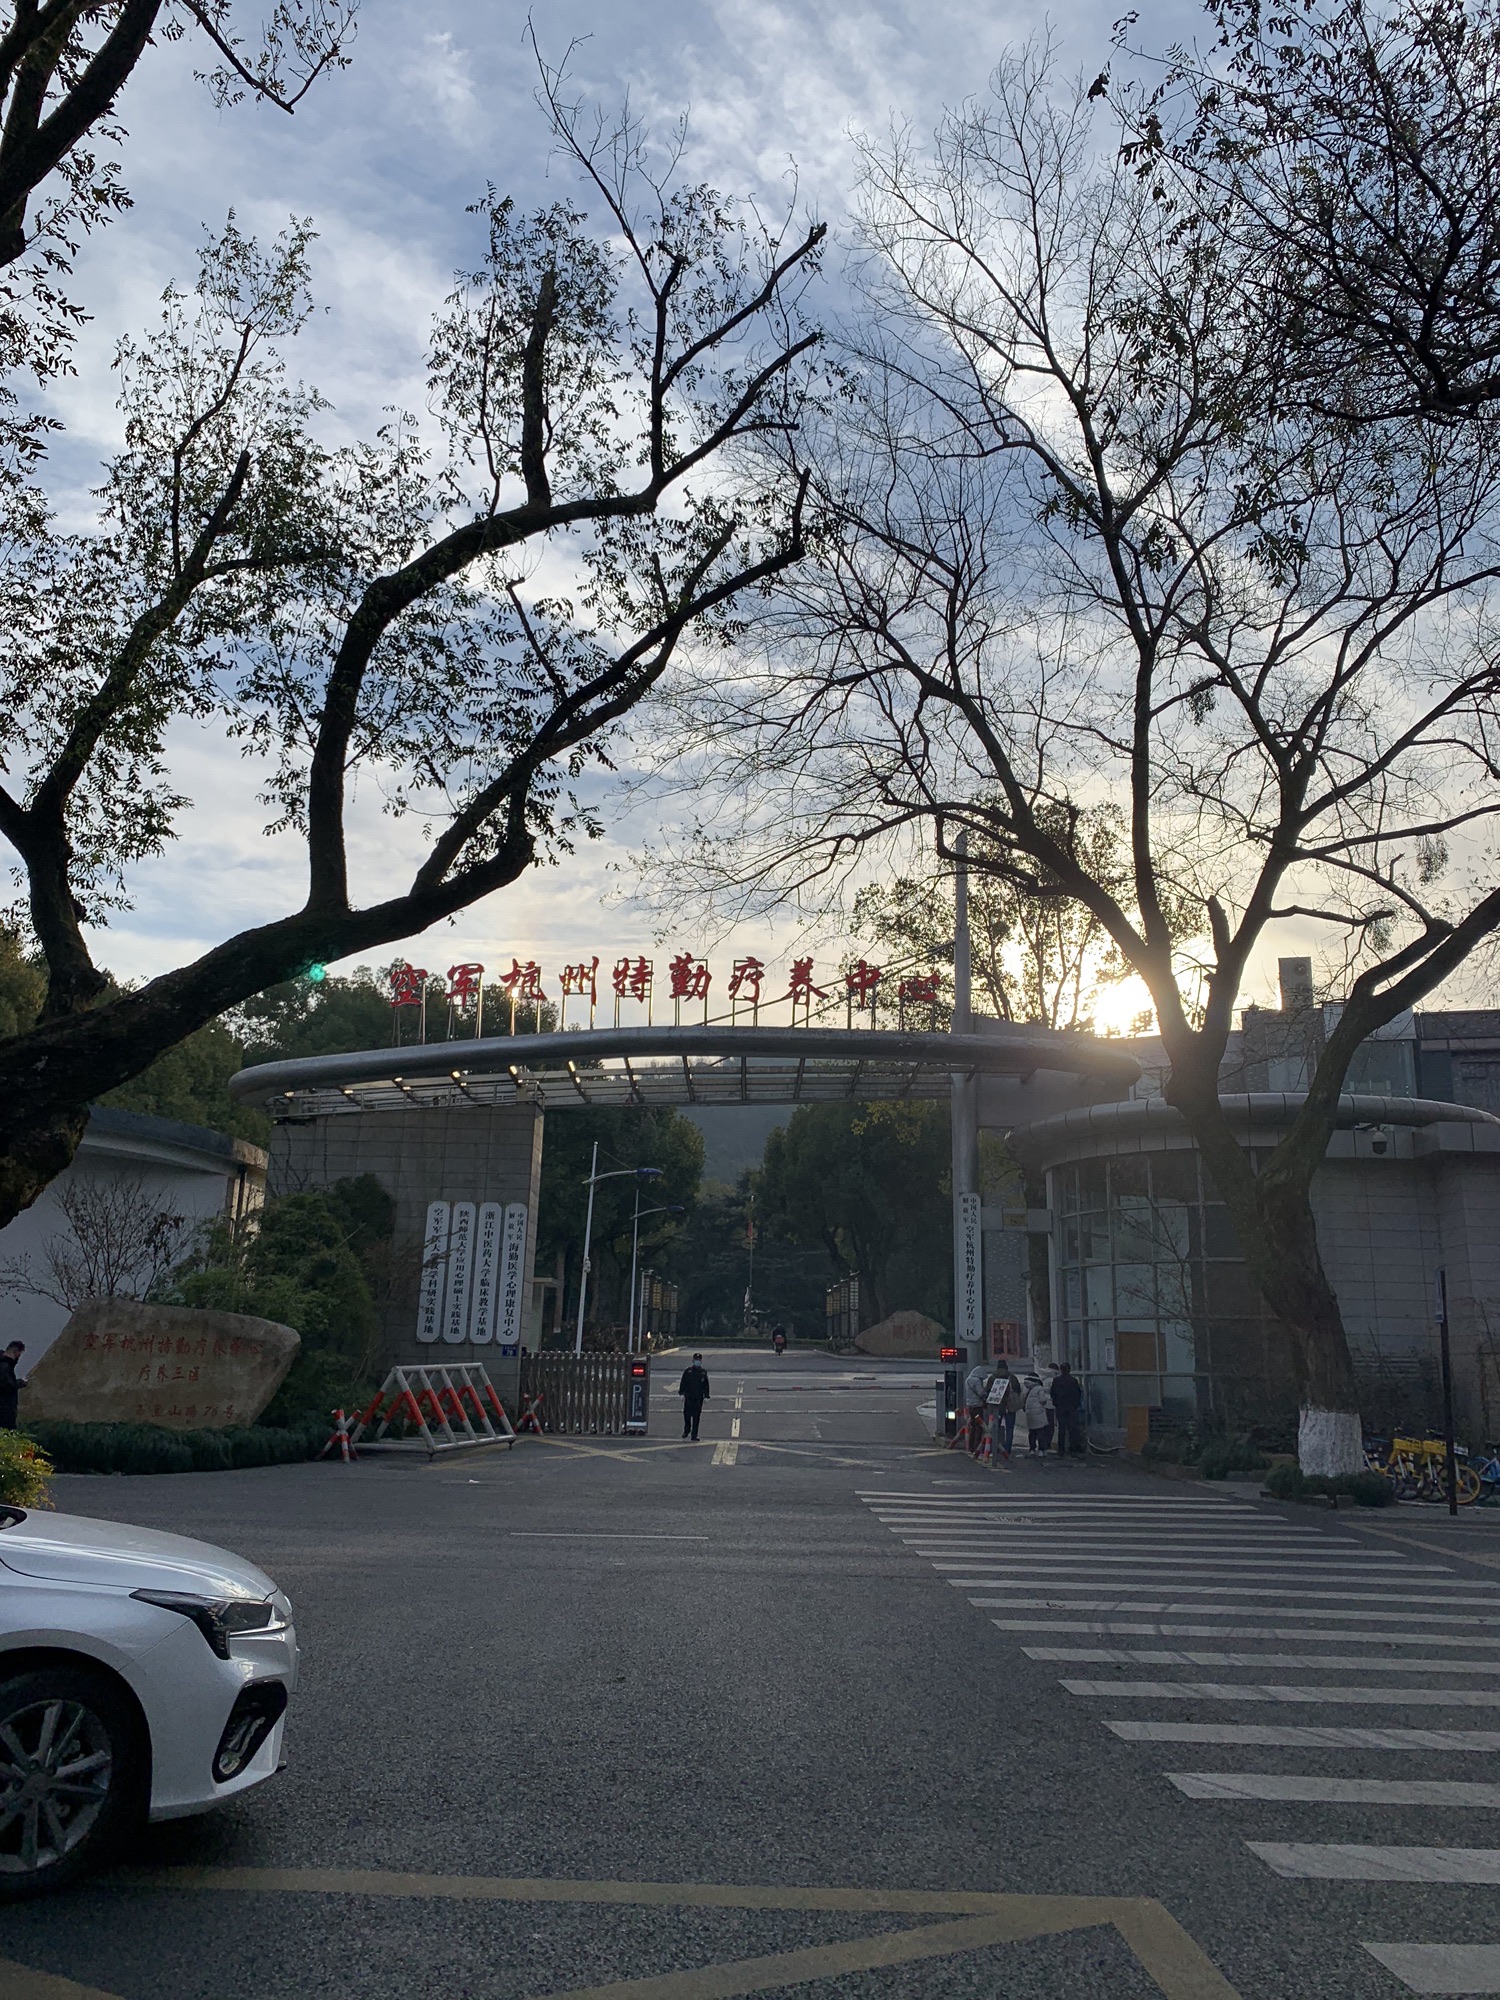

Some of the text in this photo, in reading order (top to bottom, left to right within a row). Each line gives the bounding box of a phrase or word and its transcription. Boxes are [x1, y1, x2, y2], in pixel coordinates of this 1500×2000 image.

[391, 952, 940, 1008] 空军杭州特勤疗养中心
[507, 1212, 516, 1240] 解放军
[516, 1212, 524, 1241] 中国人民
[476, 1211, 496, 1336] 浙江中医药大学临床教学基地
[138, 1363, 202, 1382] 疗养三区
